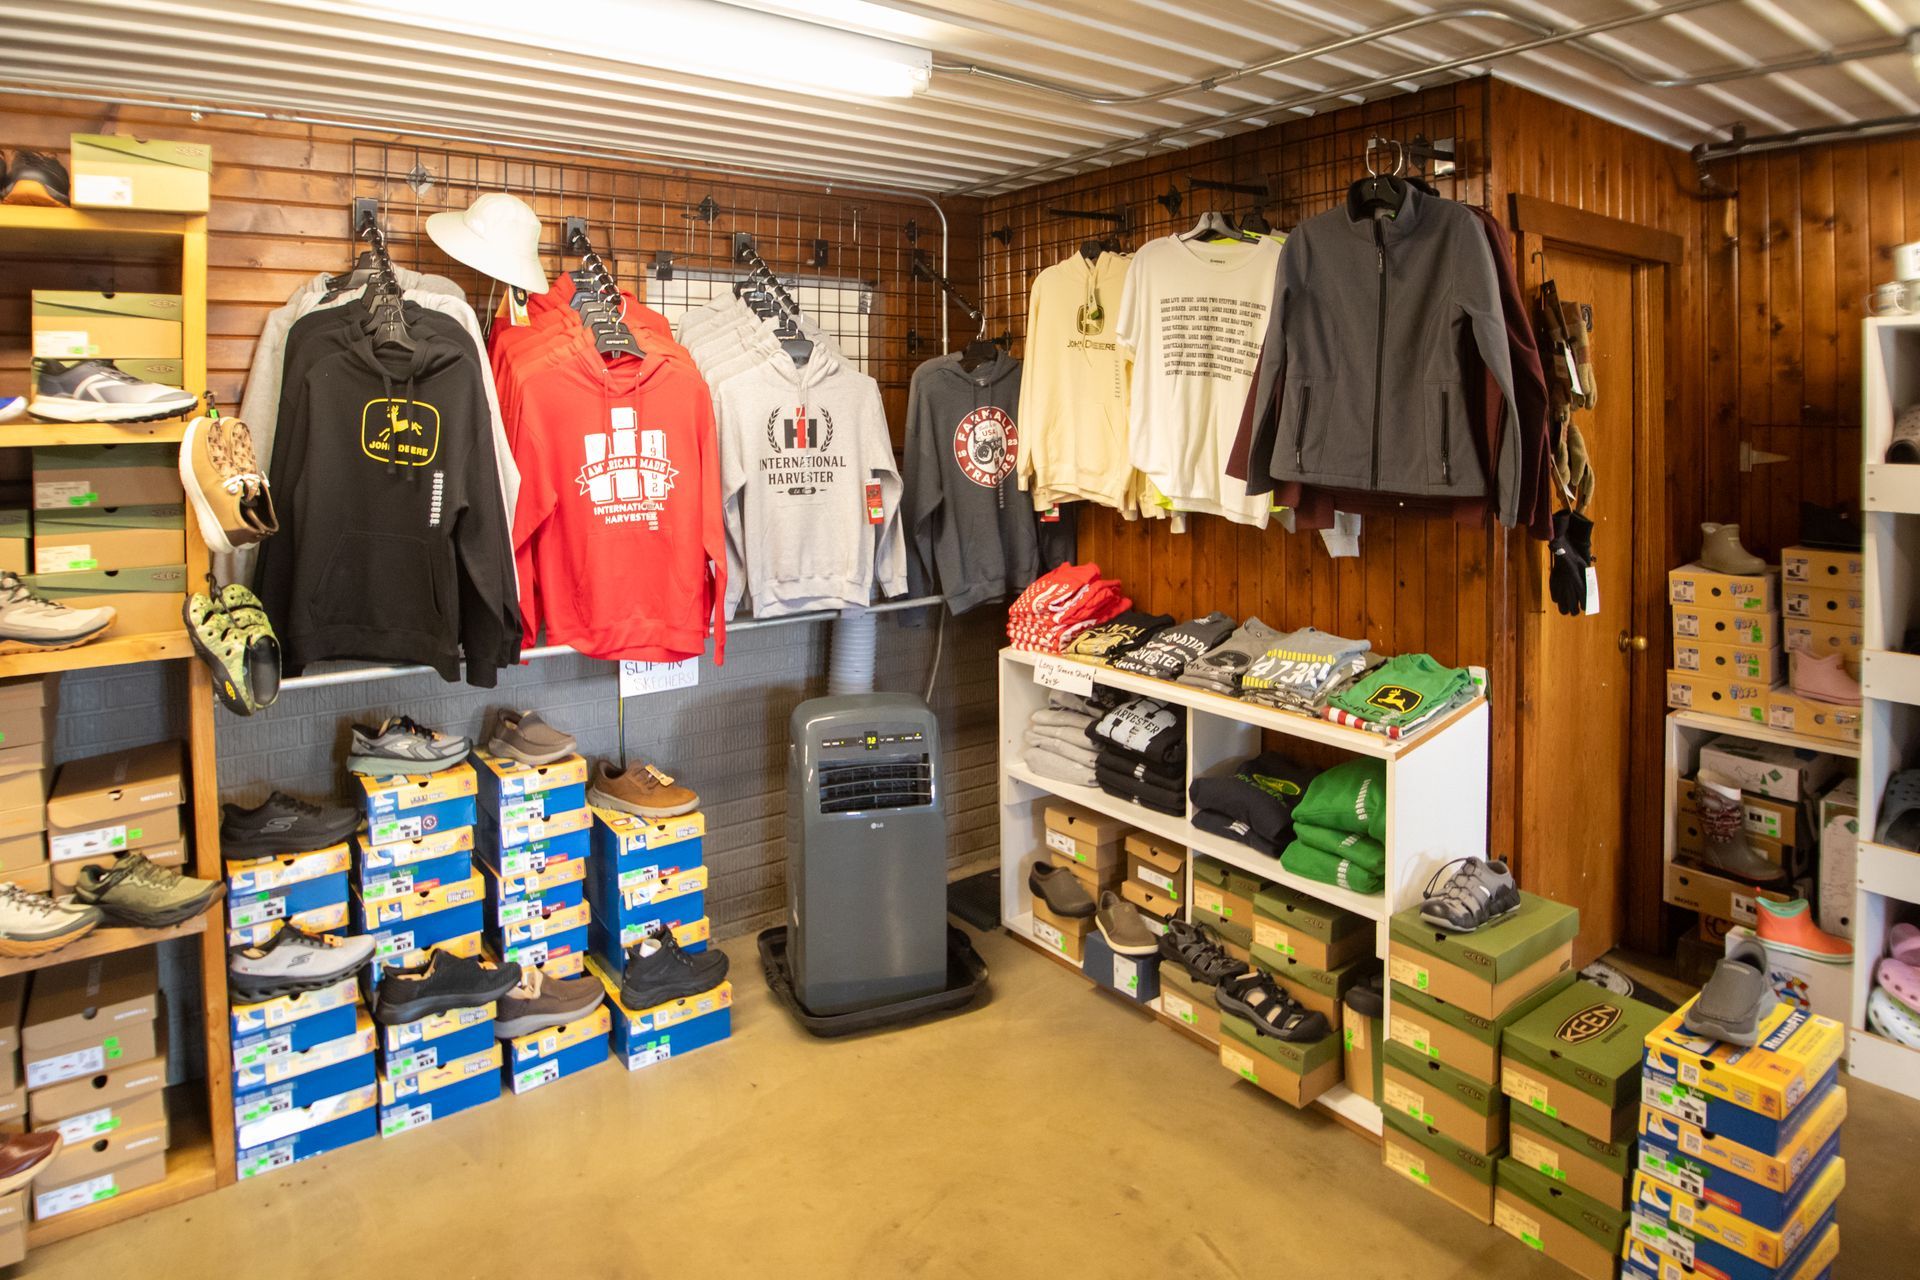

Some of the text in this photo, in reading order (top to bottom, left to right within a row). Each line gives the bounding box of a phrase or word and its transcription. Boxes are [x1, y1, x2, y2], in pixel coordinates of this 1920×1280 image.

[1085, 340, 1116, 351] DEERE
[369, 441, 429, 457] JOH DEERE
[587, 457, 667, 478] AMRICAN MADE
[760, 455, 847, 471] INTERNATIONAL
[965, 454, 1015, 484] TRACORS
[768, 471, 834, 485] HARVESTER
[605, 512, 657, 524] HARVEST
[1464, 952, 1492, 967] KEEN
[1561, 1004, 1616, 1042] KEEN
